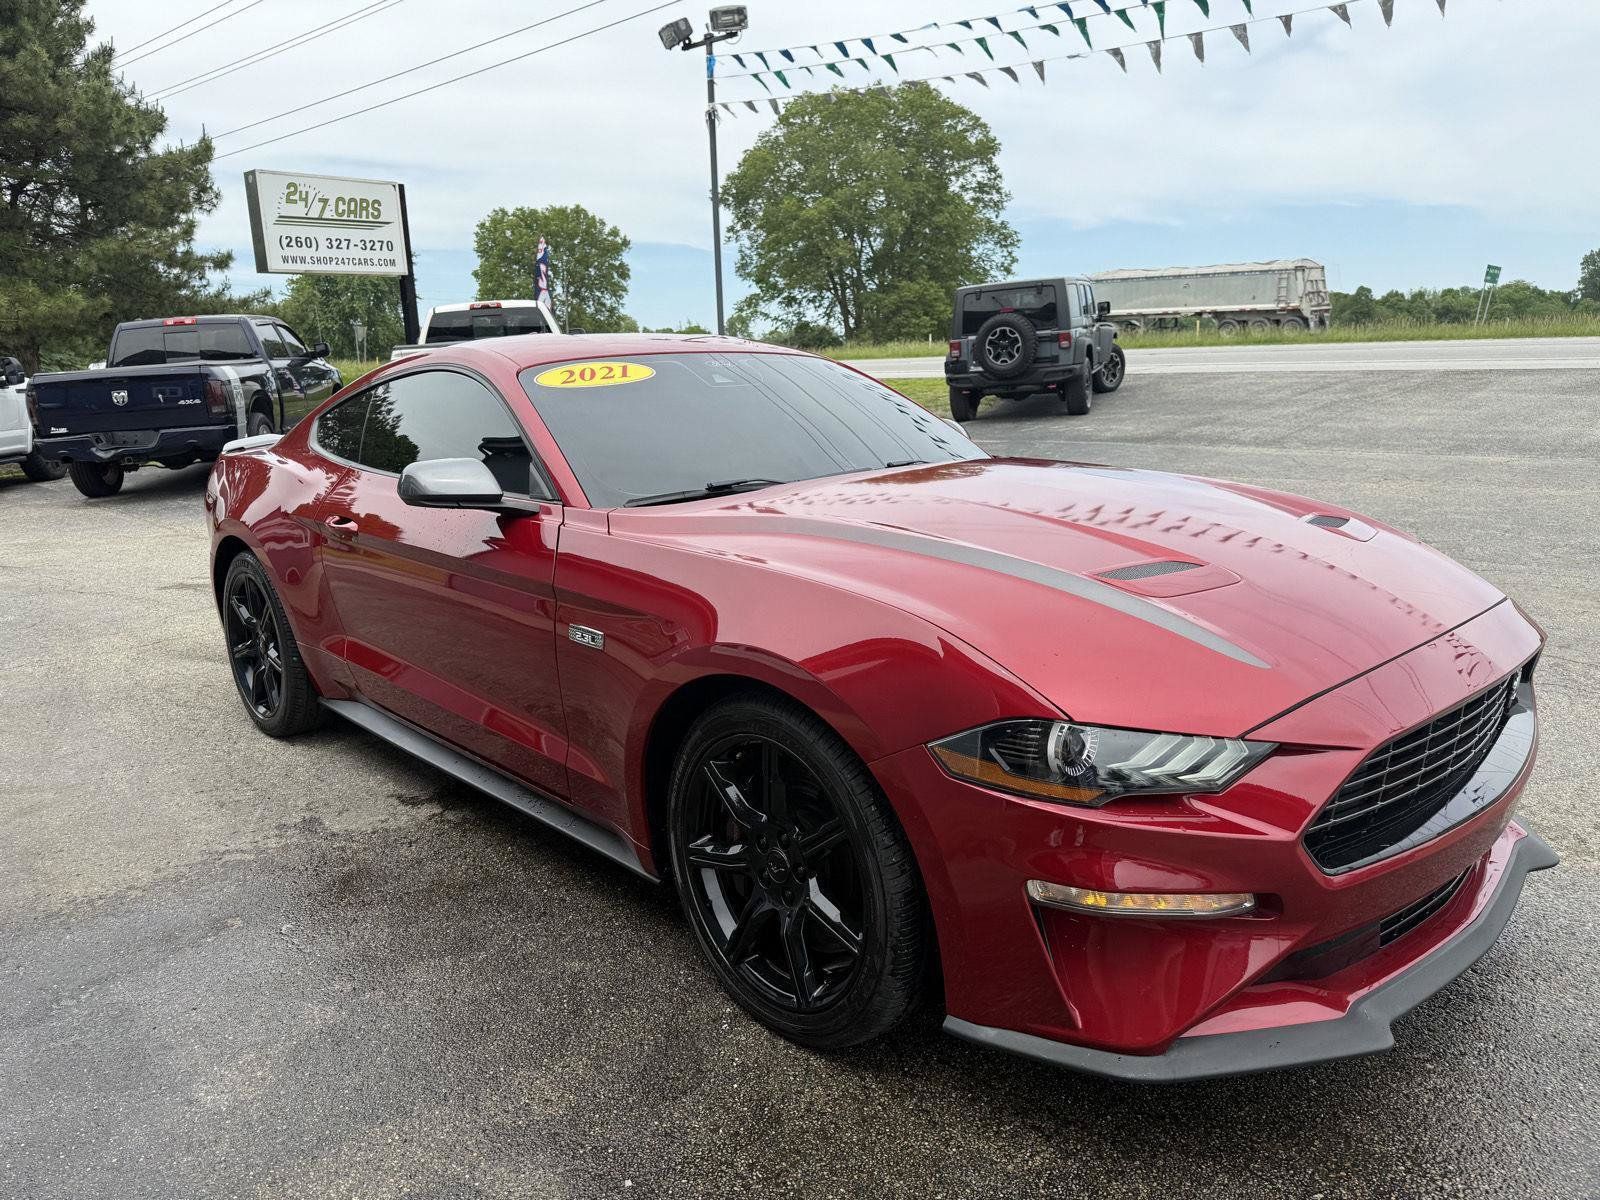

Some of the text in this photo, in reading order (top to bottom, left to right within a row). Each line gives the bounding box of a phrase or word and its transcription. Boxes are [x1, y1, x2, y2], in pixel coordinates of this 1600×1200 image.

[285, 181, 382, 220] 24/7 CARS
[279, 235, 394, 251] (260) 327-3270
[281, 254, 396, 267] WWW.SHOP247CARS.COM
[560, 364, 631, 385] 2021
